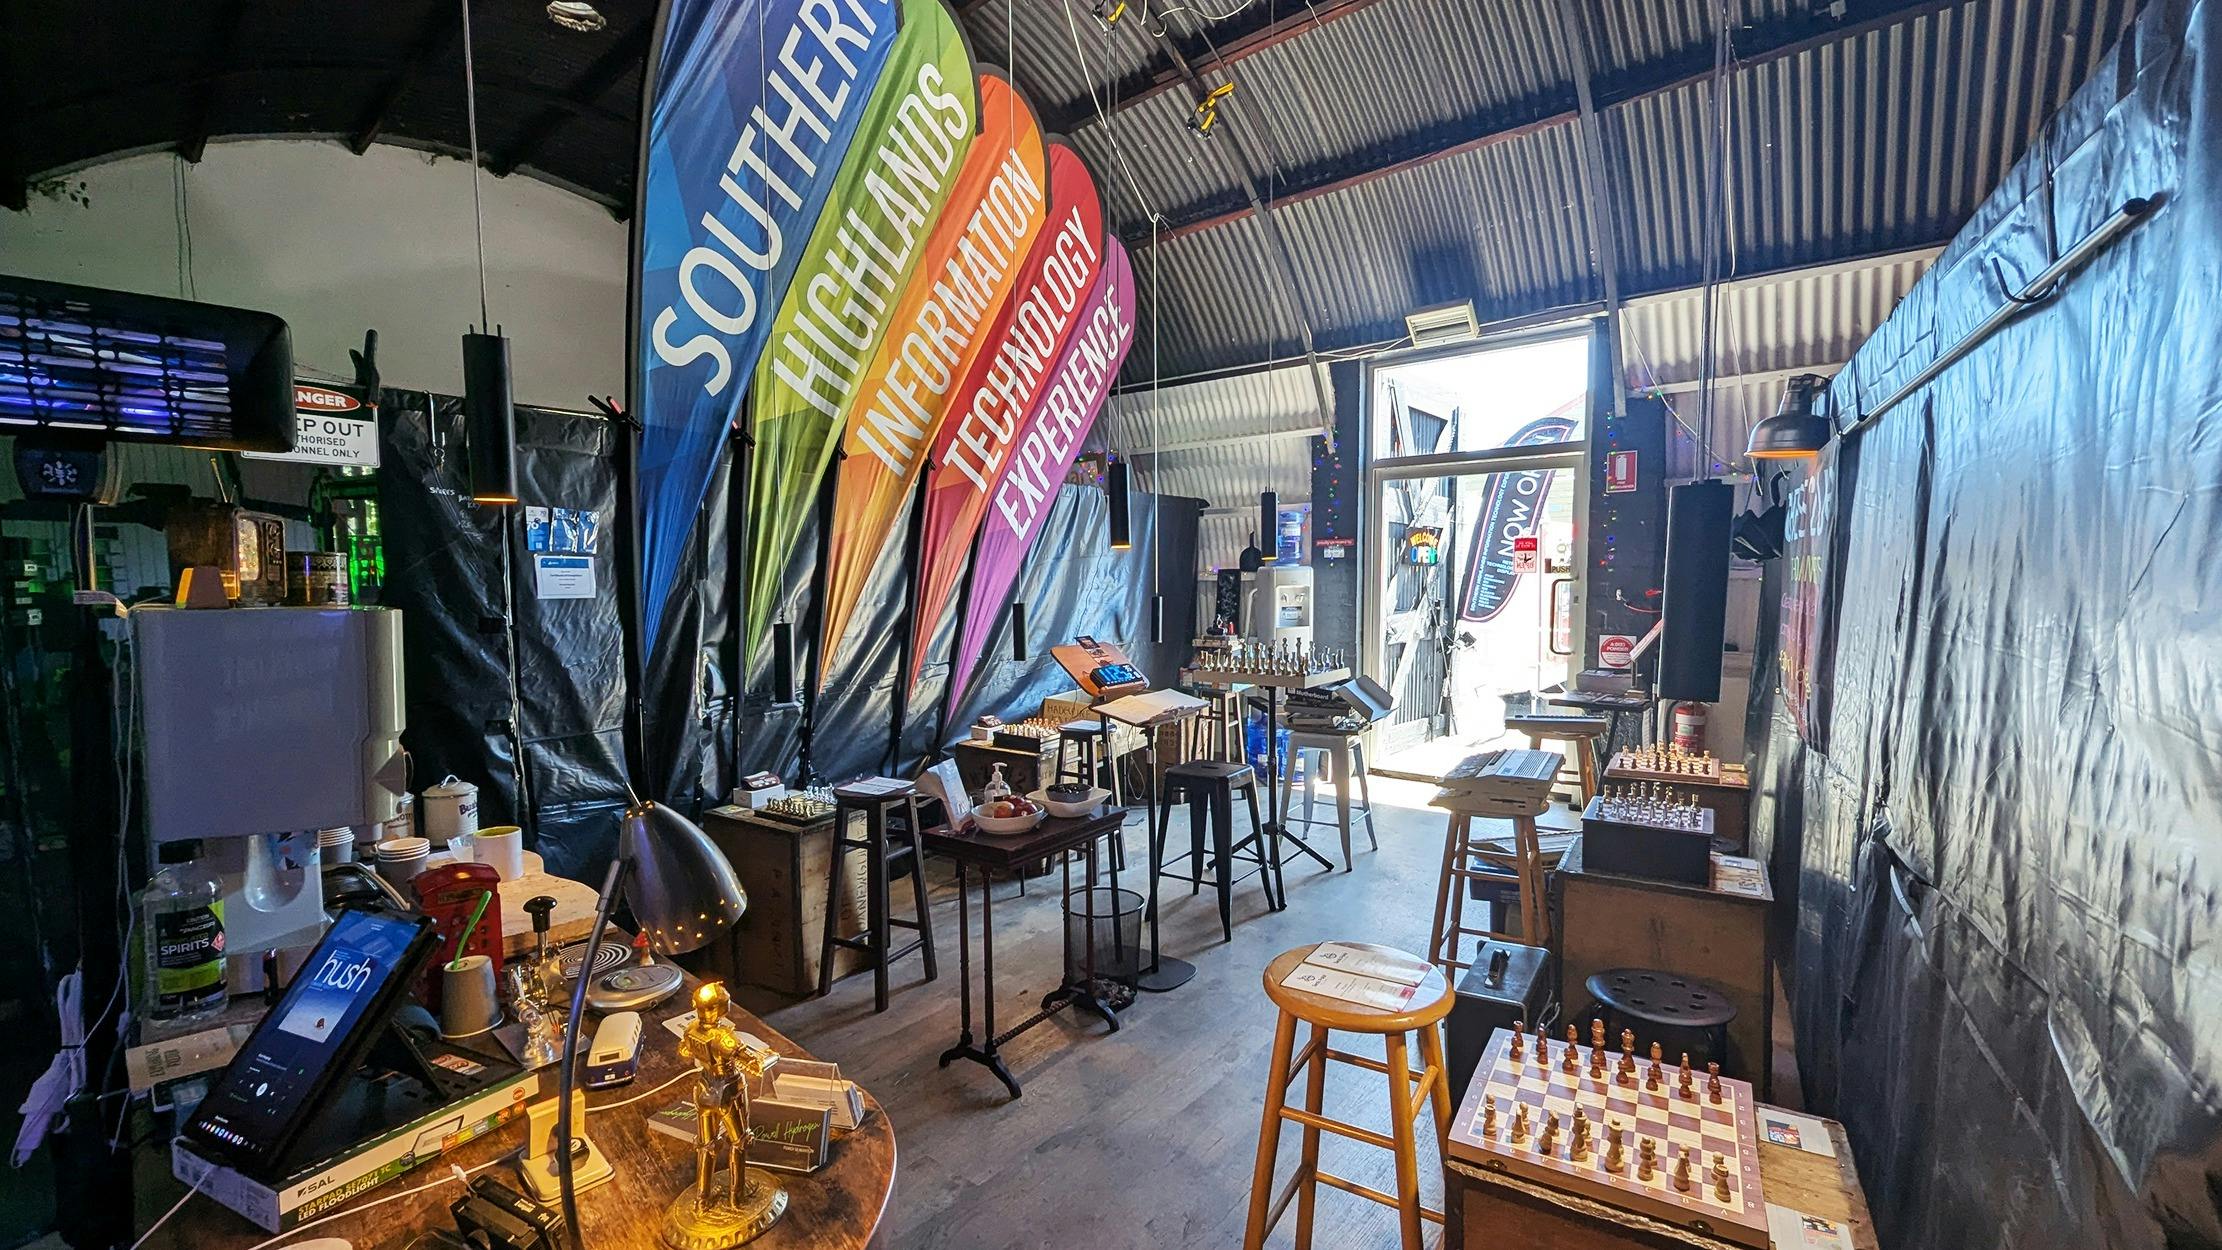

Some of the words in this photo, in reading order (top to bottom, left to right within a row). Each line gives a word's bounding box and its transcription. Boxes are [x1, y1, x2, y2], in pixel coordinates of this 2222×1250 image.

[769, 63, 969, 420] HIGHLANDS
[857, 147, 1042, 476] INFORMATION
[942, 205, 1098, 495] TECHNOLOGY
[295, 391, 348, 408] NGER
[994, 283, 1131, 542] EXPERIENCE
[297, 434, 346, 447] THORISED
[323, 420, 364, 438] OUT
[293, 446, 330, 457] ONNEL
[333, 448, 360, 459] ONLY
[1491, 489, 1505, 521] TECHNOLOGY
[1498, 498, 1531, 557] NOW
[1411, 546, 1438, 564] OPEN
[1551, 565, 1571, 573] PUSH
[160, 937, 210, 956] SPIRITS
[314, 950, 372, 993] hush
[308, 1175, 336, 1194] SAL
[298, 1208, 317, 1222] LED
[318, 1175, 380, 1213] FLOODLIGHT
[298, 1188, 343, 1213] STARPAD
